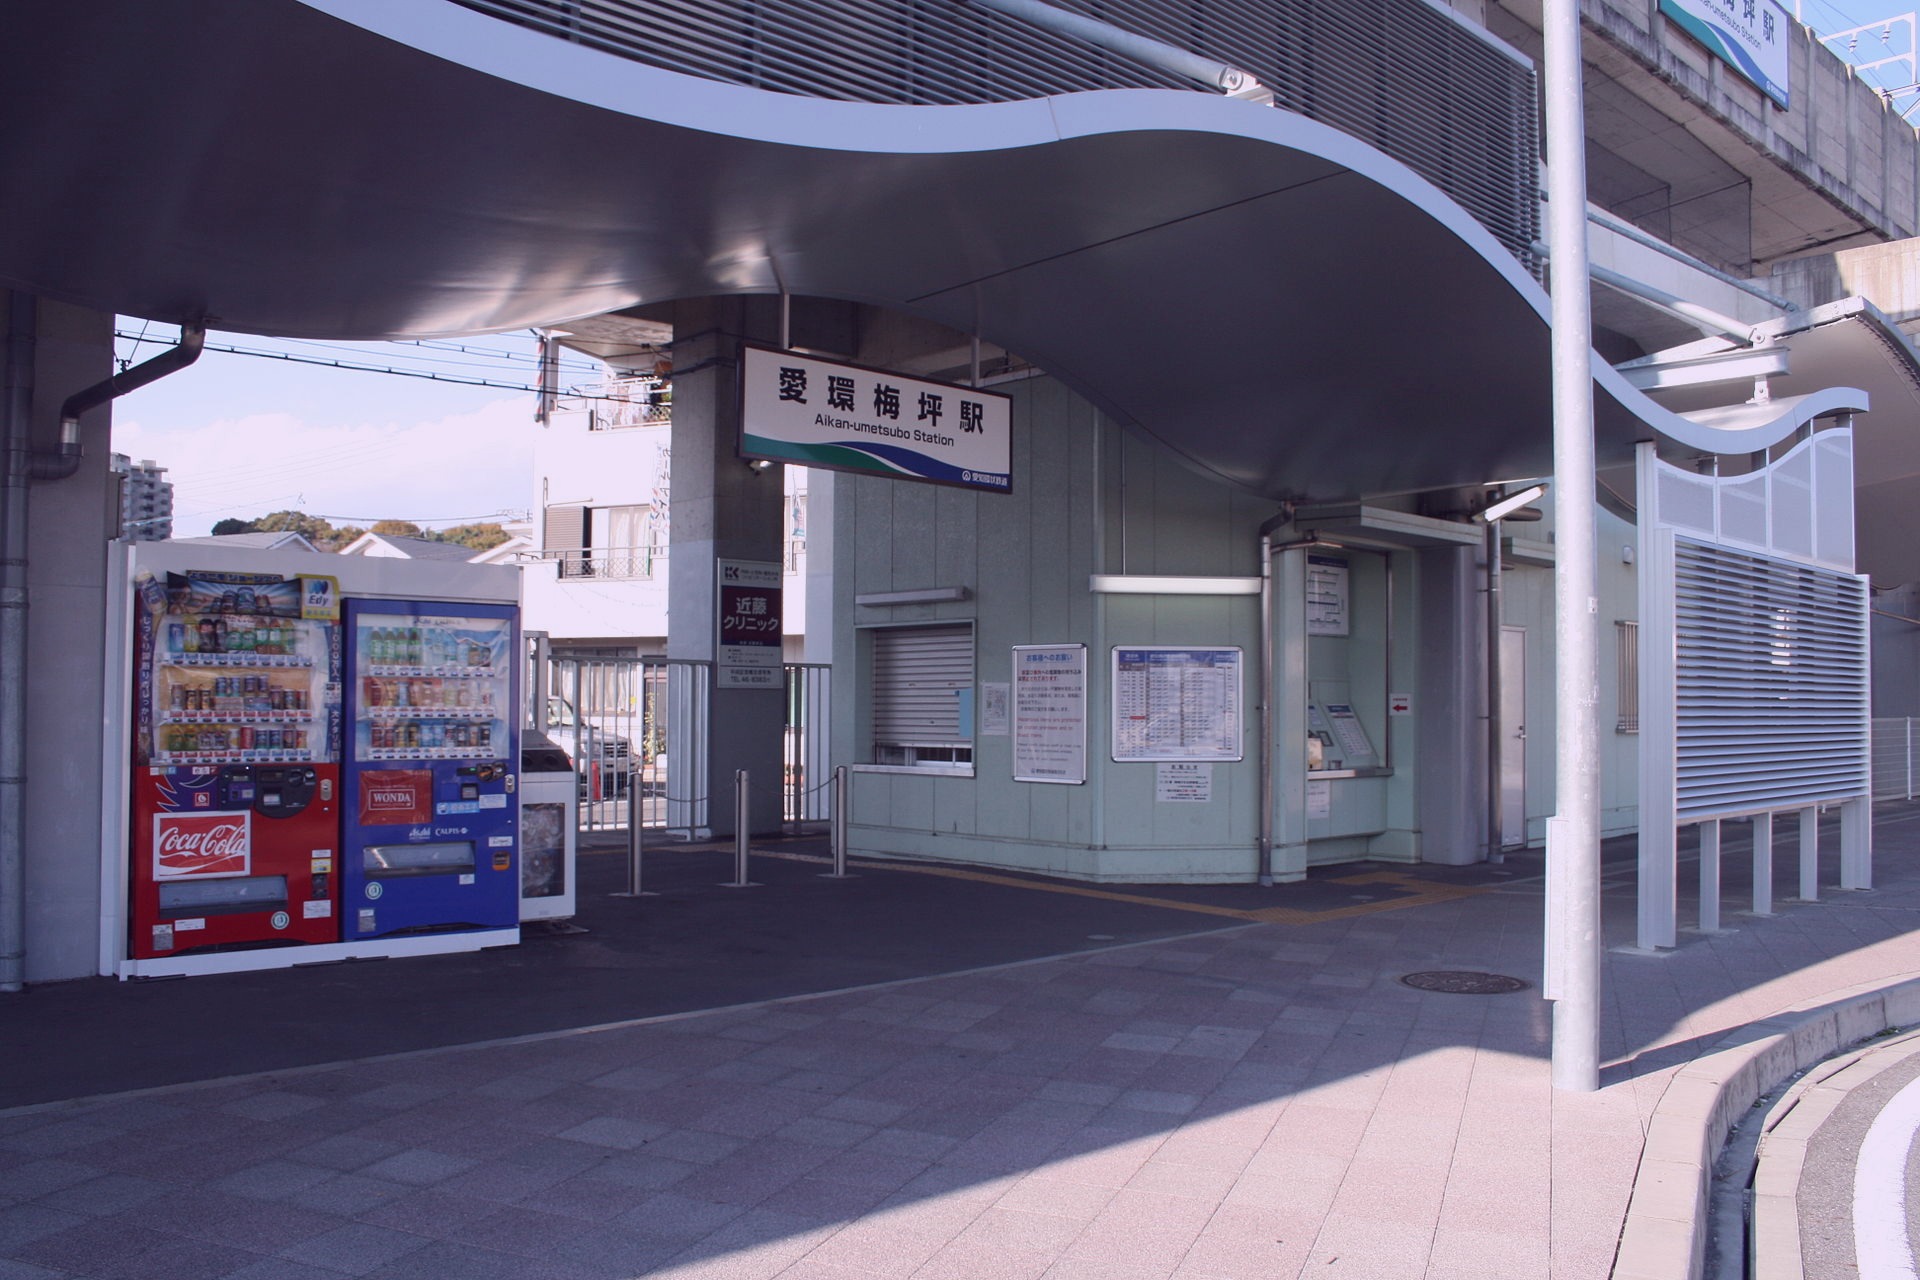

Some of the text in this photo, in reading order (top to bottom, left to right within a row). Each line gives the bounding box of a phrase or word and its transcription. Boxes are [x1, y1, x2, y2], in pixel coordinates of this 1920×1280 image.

[1741, 25, 1761, 50] Station
[779, 366, 984, 435] 愛環梅坪駅
[815, 413, 954, 447] Aikan-umetsubo Station
[308, 595, 329, 606] Edy
[736, 597, 767, 615] 近藤
[724, 615, 779, 632] クリニック
[373, 792, 411, 803] WONDA
[408, 827, 460, 838] Asahi CALPIS
[159, 824, 246, 860] Coca-Cola
